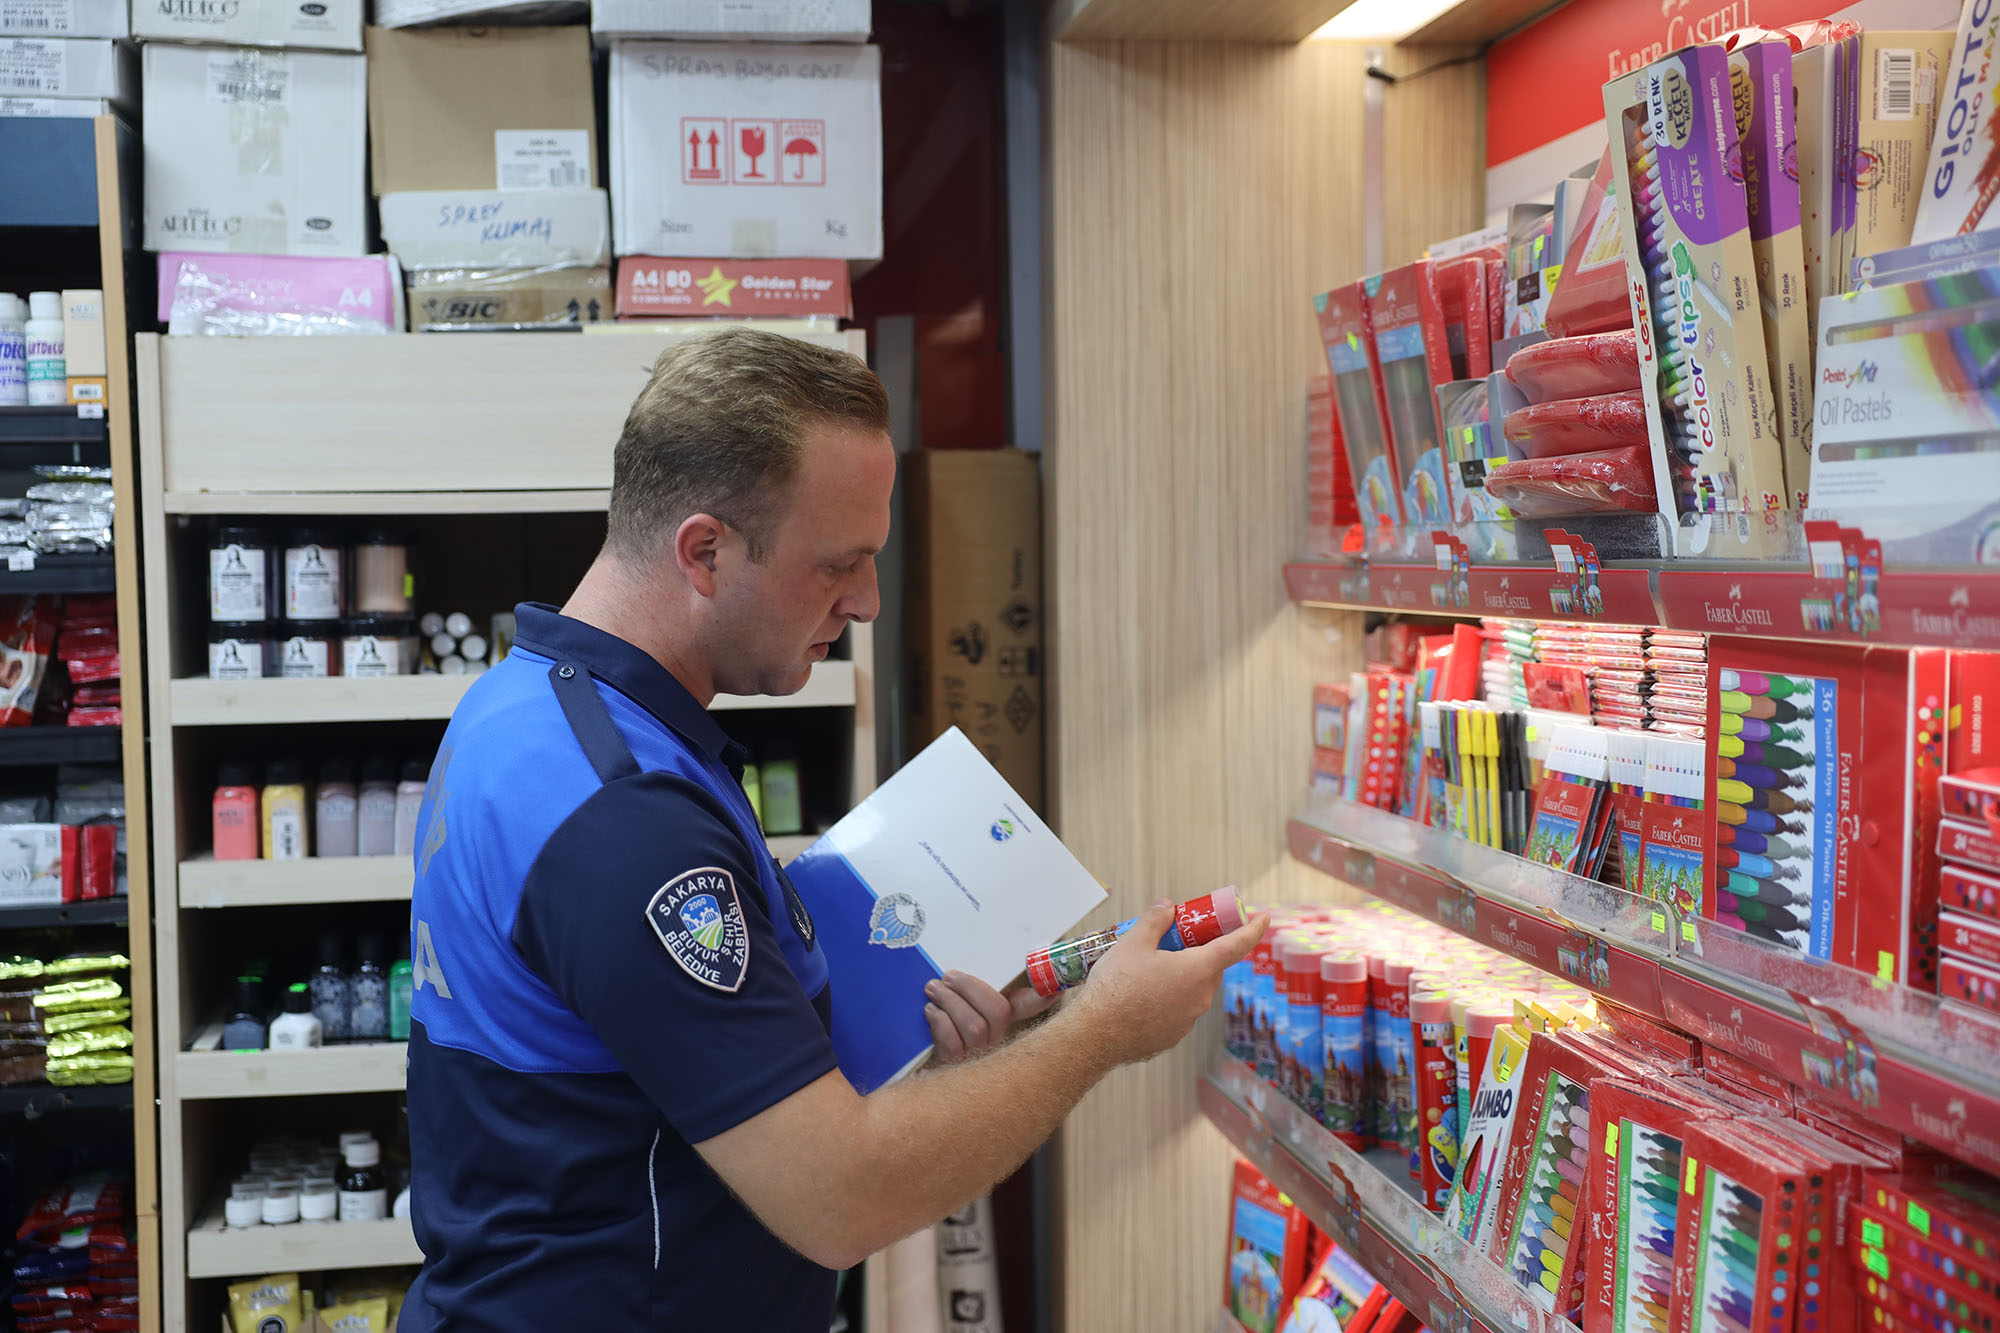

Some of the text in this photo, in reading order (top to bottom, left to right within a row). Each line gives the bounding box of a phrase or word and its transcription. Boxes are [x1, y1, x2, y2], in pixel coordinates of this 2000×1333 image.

[1654, 121, 1665, 140] 30
[1961, 91, 1983, 156] OLIO
[1687, 153, 1706, 220] CREATE
[632, 269, 692, 289] A4 80
[741, 275, 834, 291] Golden Star
[1733, 275, 1744, 312] 30 Renk
[1781, 272, 1791, 295] Renk
[338, 287, 373, 308] A4
[1676, 280, 1713, 448] color tips
[1745, 364, 1756, 393] Kalem
[1786, 363, 1797, 390] Kalem
[1823, 367, 1848, 385] Pentel
[1820, 390, 1893, 426] Oil Pastels
[1705, 603, 1774, 626] FABER-CASTELL
[1821, 687, 1833, 713] 36
[1824, 718, 1835, 759] Pastel
[1823, 761, 1834, 797] Boya
[1542, 796, 1579, 817] FABER-CASTELL
[1651, 825, 1703, 848] FABER-CASTELL
[1823, 812, 1834, 834] Oil
[1837, 751, 1853, 901] FABER-CASTELL
[1822, 838, 1833, 884] Pastels
[659, 876, 726, 916] SAKARYA
[688, 897, 707, 911] 2000
[678, 930, 720, 963] BÜYÜK
[728, 901, 747, 967] ZABITASI
[665, 930, 721, 982] BELEDİYE
[1706, 1012, 1774, 1059] FABER-CASTELL
[1472, 1088, 1513, 1120] JUMBO
[1497, 1072, 1548, 1263] FABER-CASTELL
